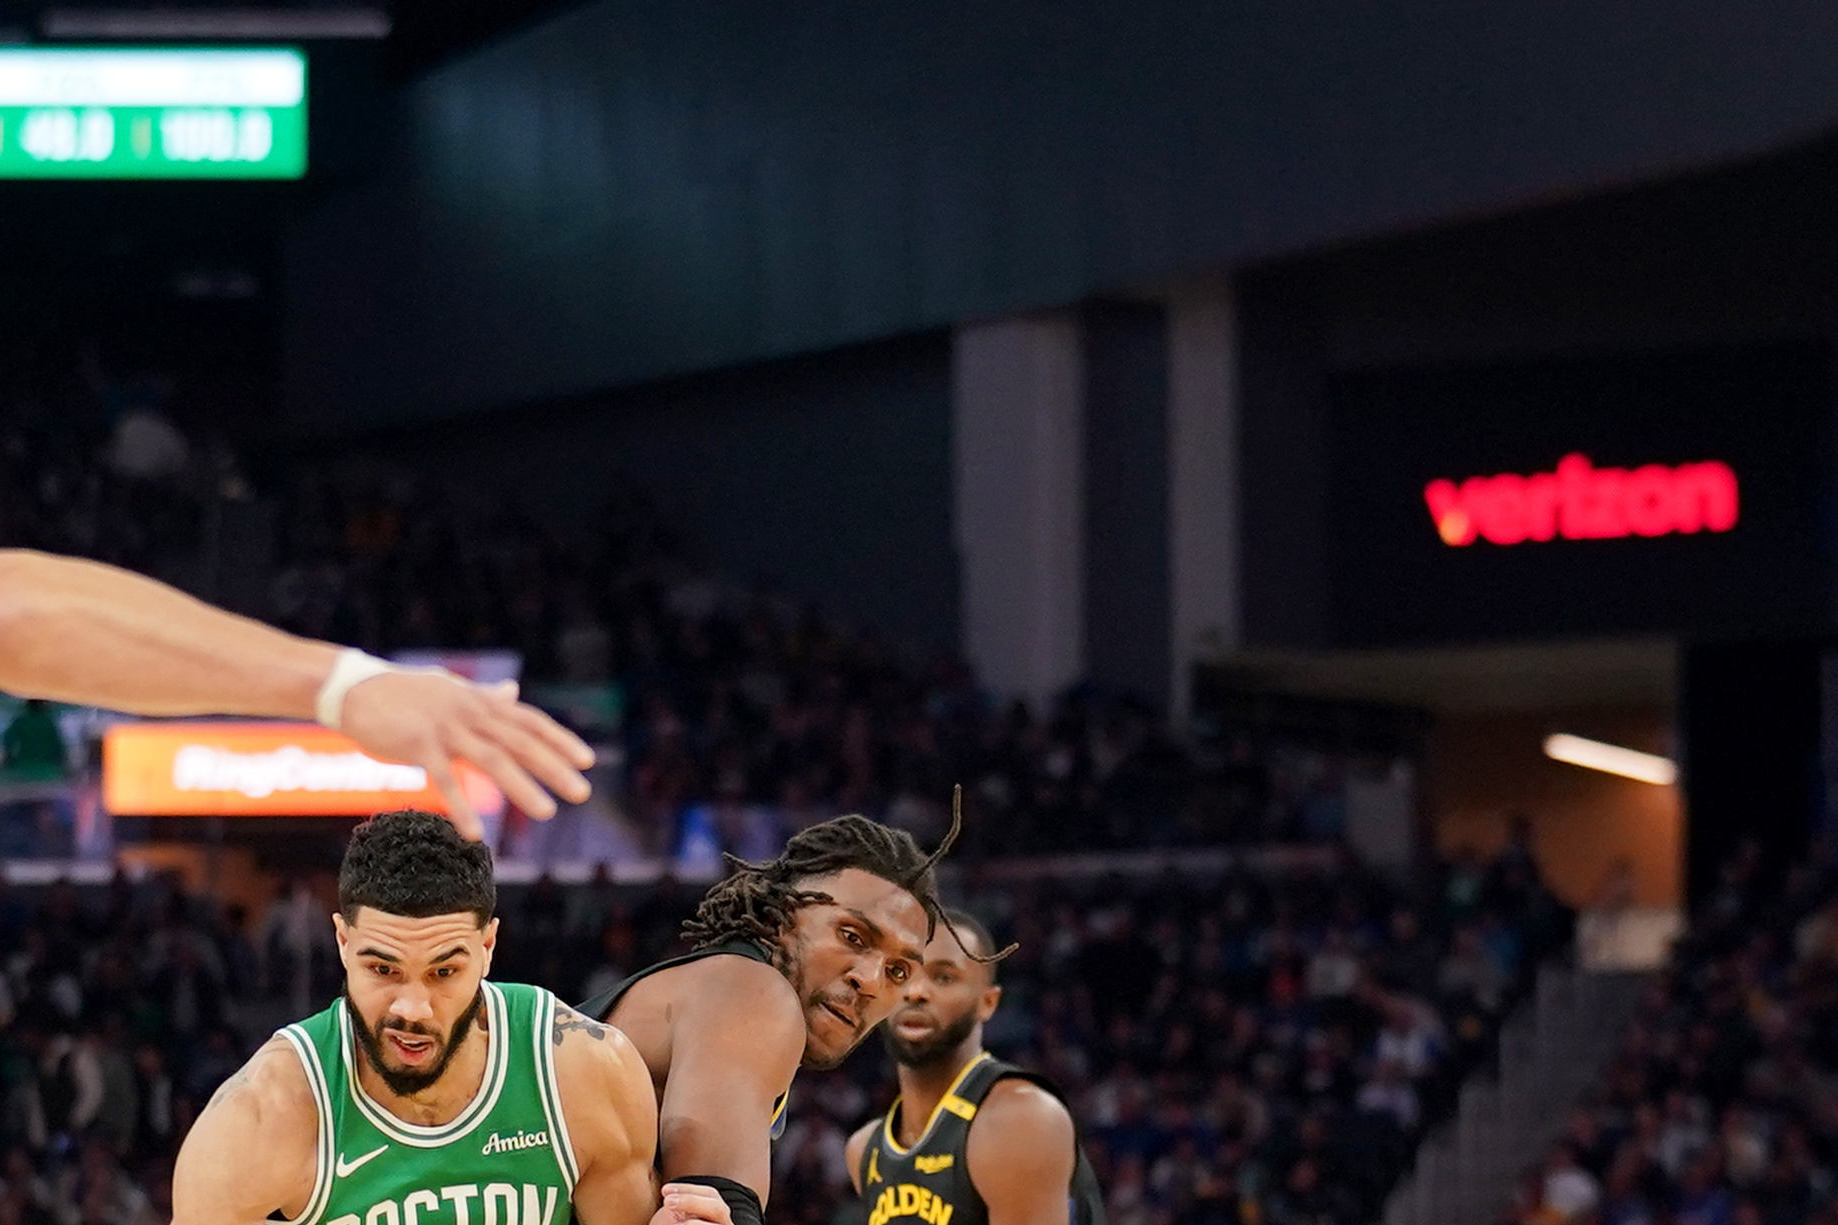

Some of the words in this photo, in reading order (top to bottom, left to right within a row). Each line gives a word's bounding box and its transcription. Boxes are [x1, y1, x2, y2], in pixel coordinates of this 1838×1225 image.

[1423, 451, 1739, 547] verizon
[172, 743, 429, 798] RingCentra
[481, 1130, 549, 1156] Amica
